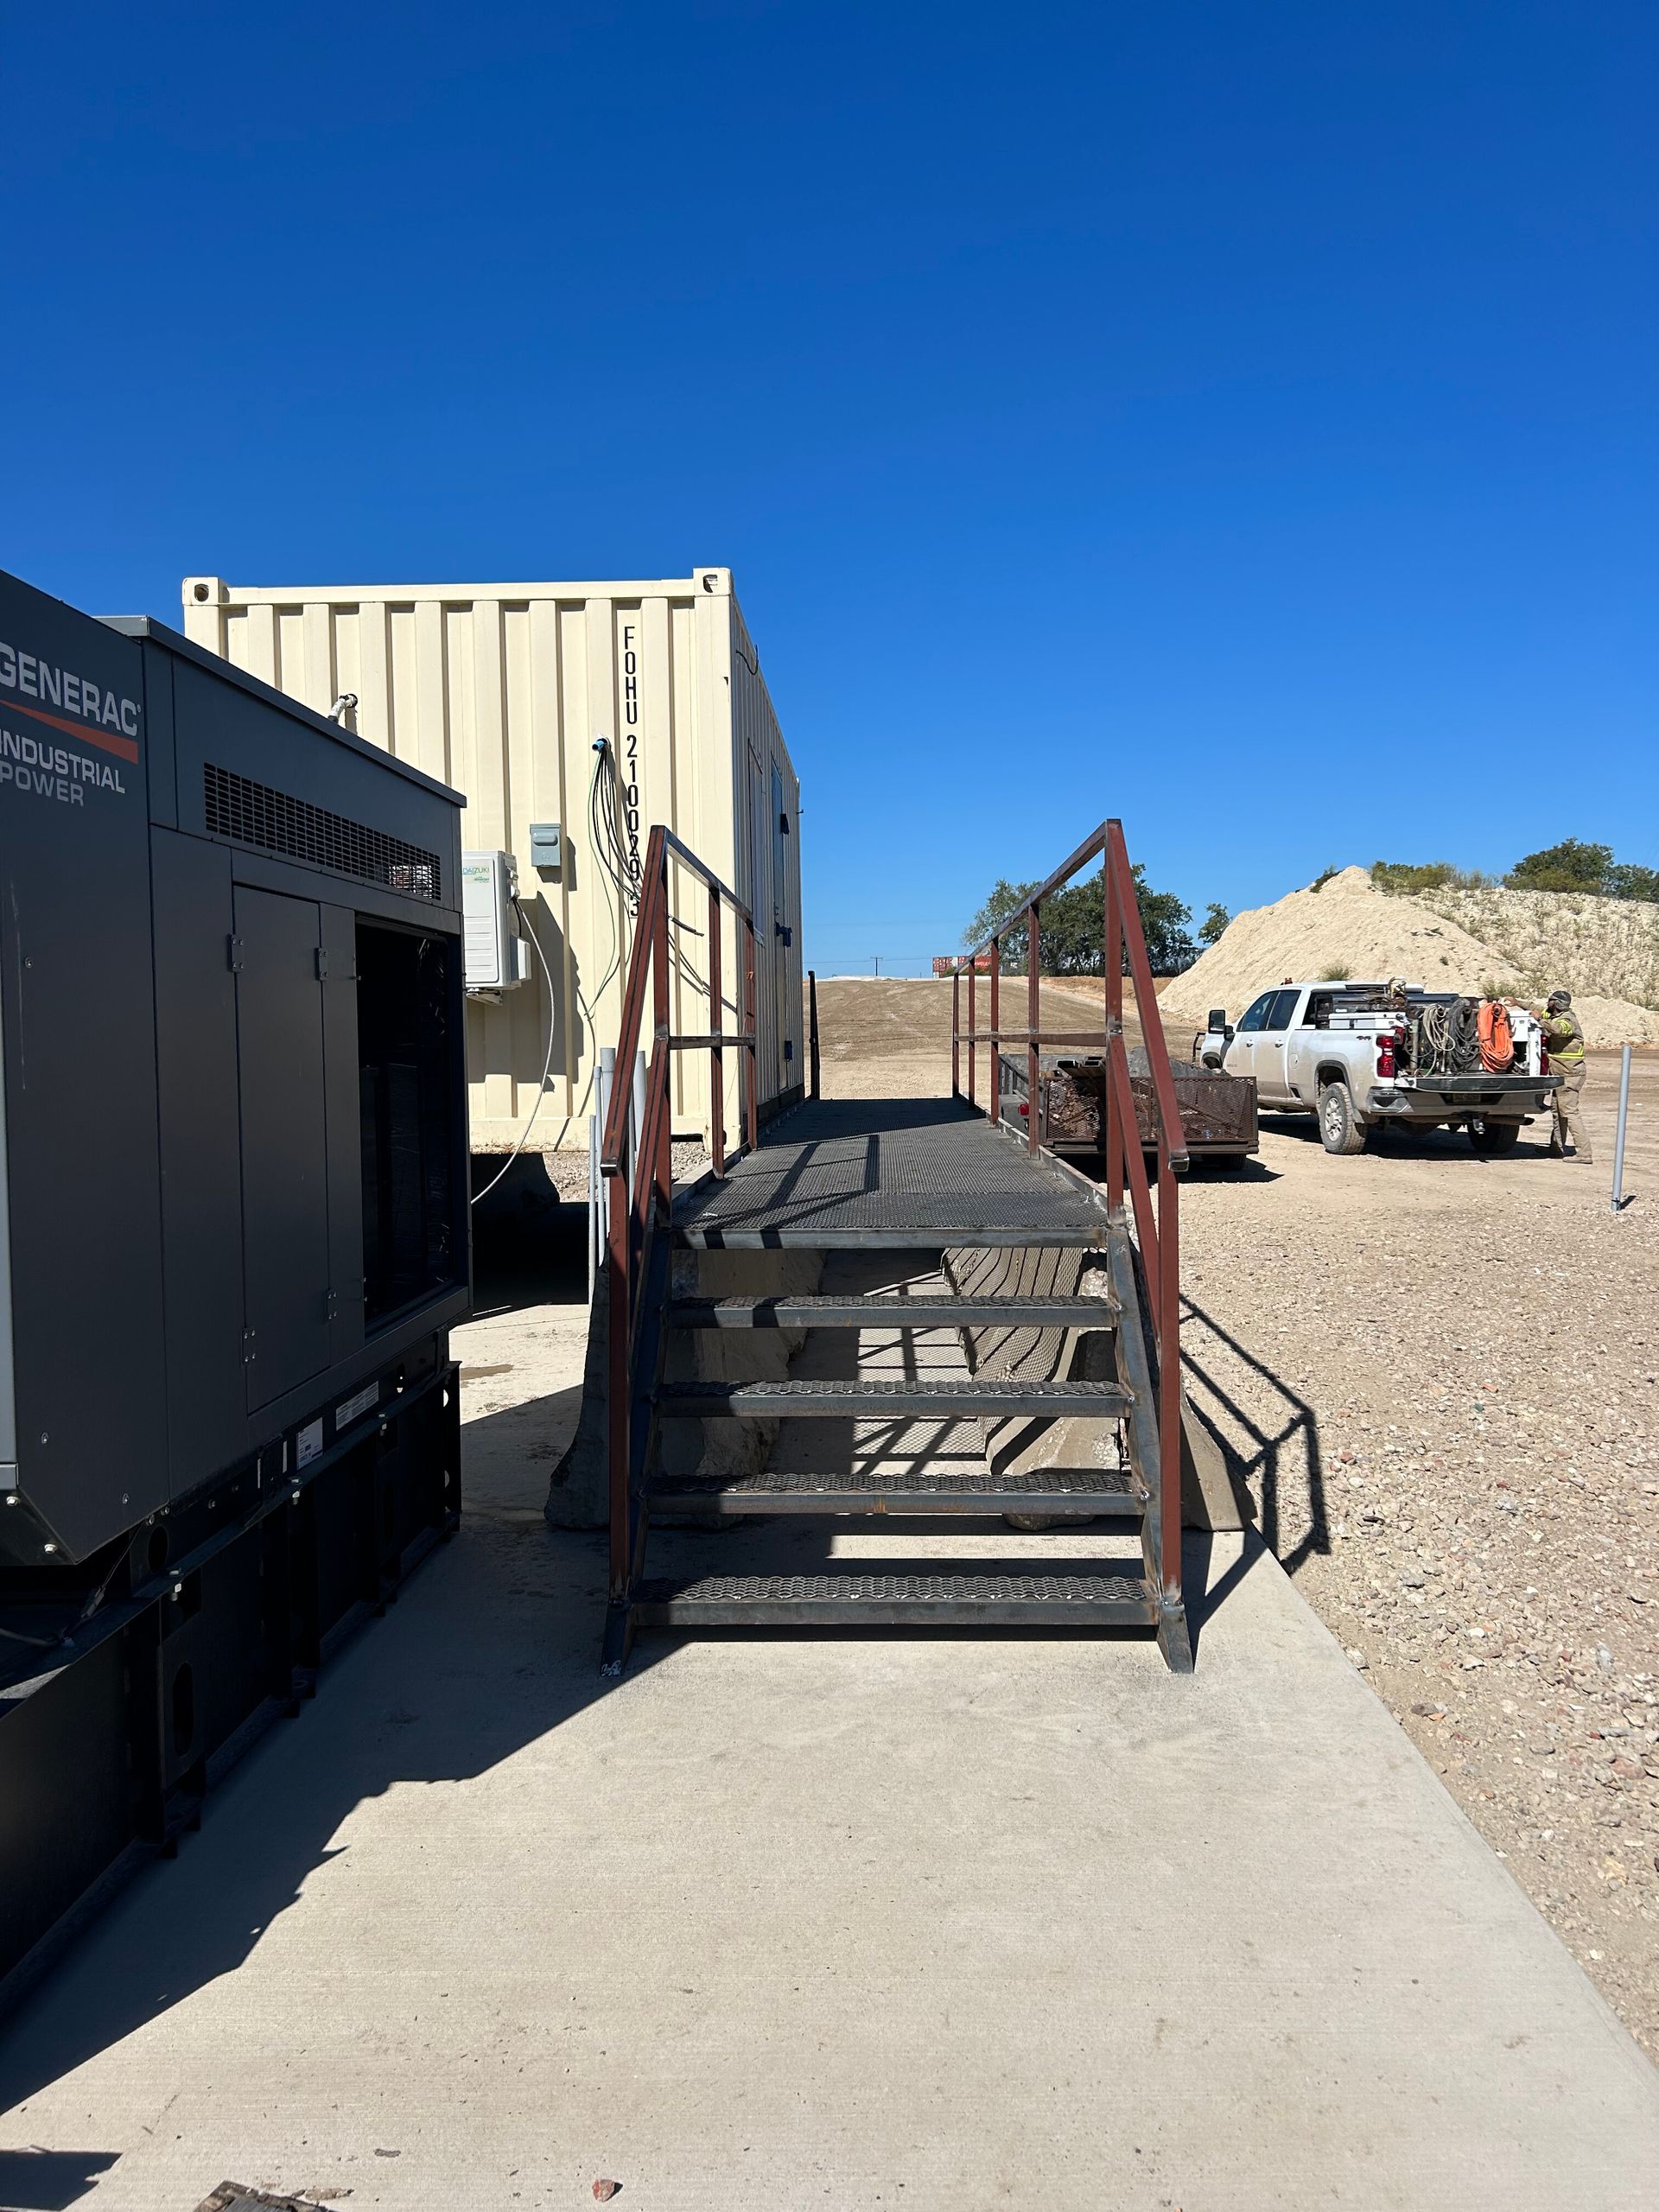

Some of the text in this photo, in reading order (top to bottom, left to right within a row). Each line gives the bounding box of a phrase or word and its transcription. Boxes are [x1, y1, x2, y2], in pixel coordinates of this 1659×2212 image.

[0, 642, 138, 736] GENERAC
[625, 626, 638, 725] FOHU
[0, 760, 84, 806] POWER
